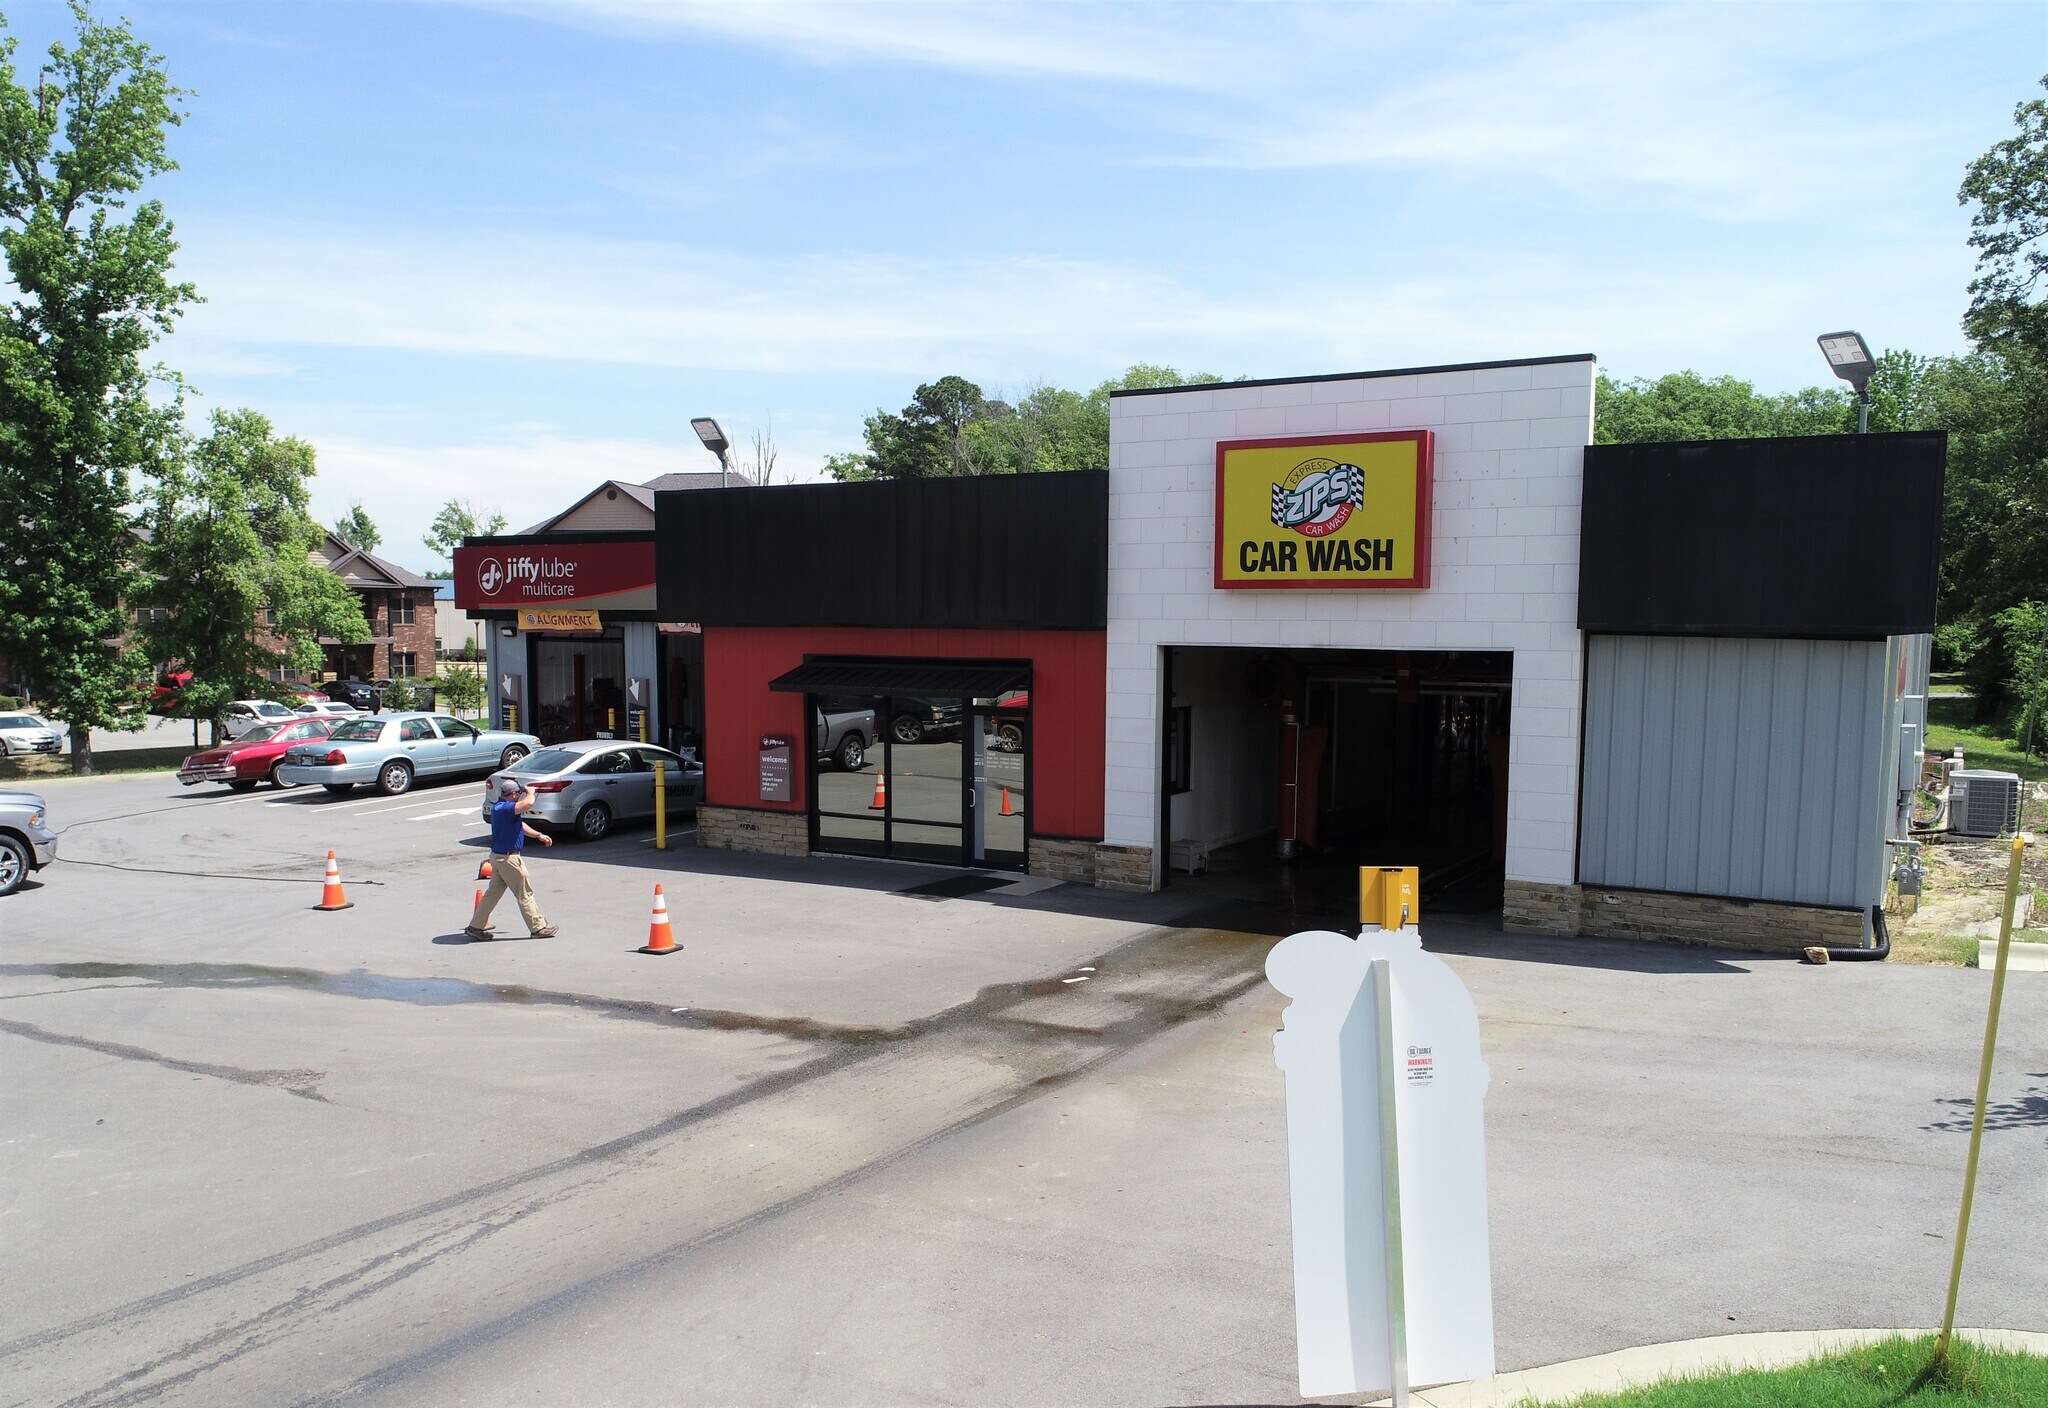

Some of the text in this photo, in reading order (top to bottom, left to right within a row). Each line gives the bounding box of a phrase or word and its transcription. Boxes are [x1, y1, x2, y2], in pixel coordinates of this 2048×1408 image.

[1289, 461, 1328, 485] EXPRESS
[1285, 470, 1350, 522] ZIPS
[1305, 507, 1350, 535] CAR WASH
[1239, 539, 1394, 572] CAR WASH
[522, 581, 575, 595] multicare
[537, 615, 592, 625] ALIGNMENT
[651, 784, 697, 798] TRMINIX
